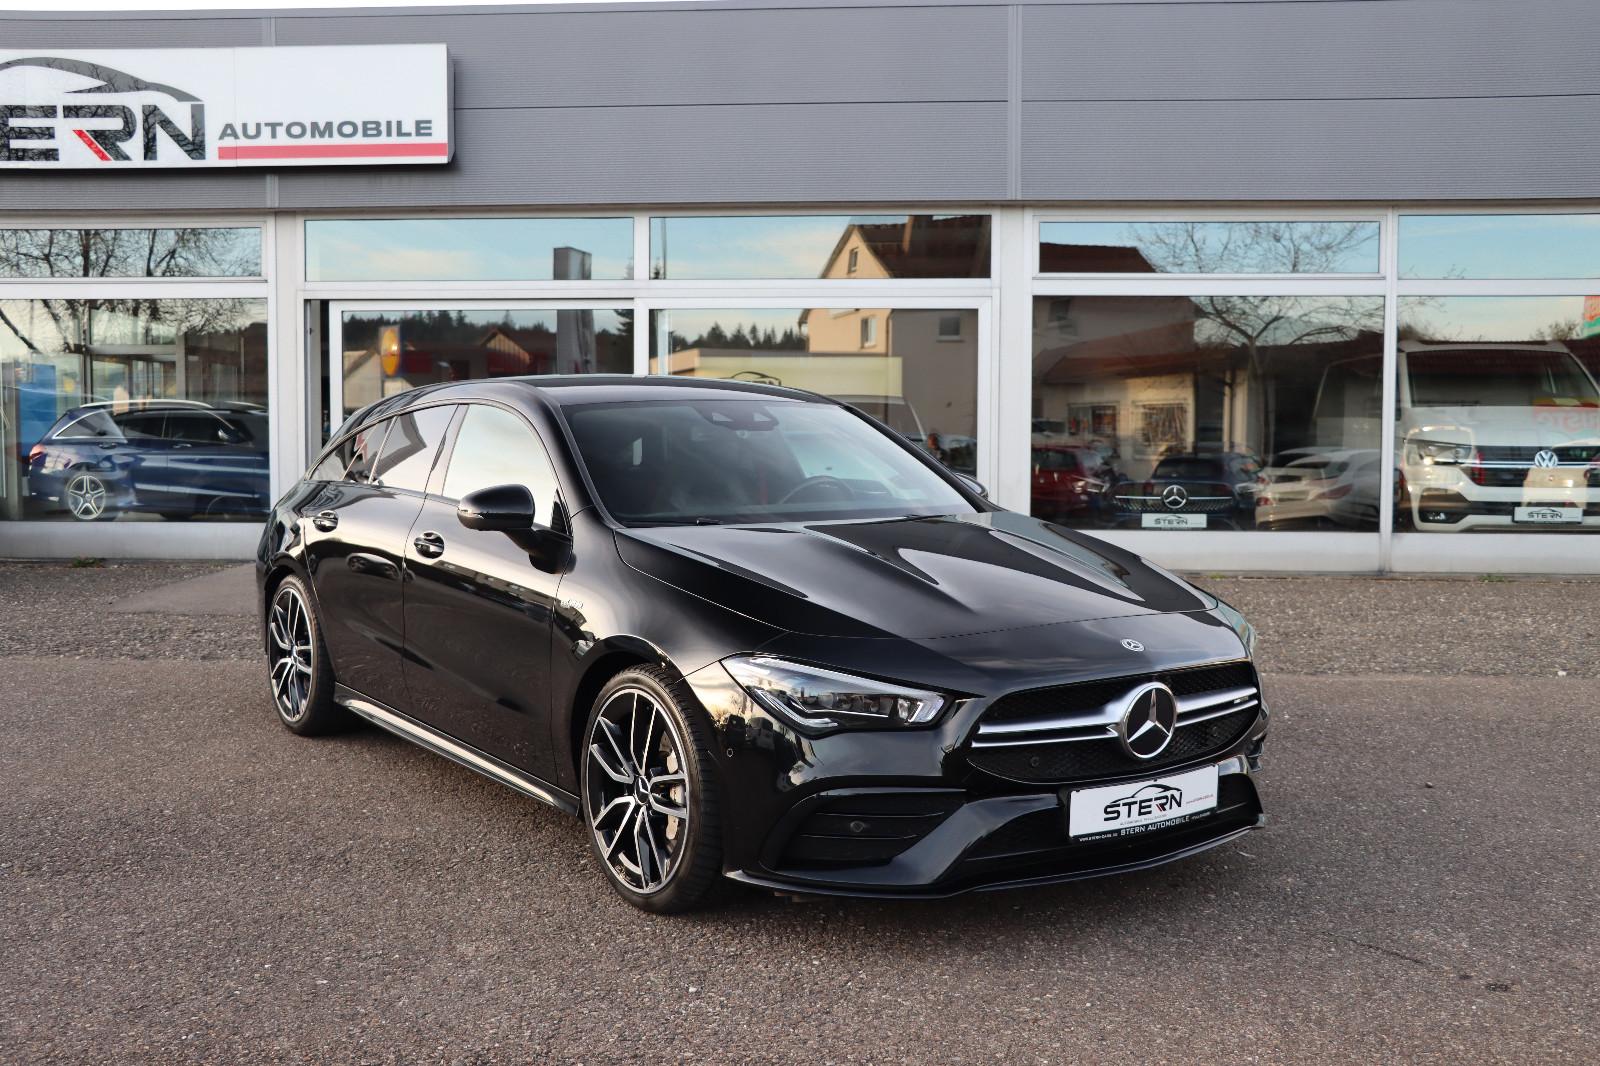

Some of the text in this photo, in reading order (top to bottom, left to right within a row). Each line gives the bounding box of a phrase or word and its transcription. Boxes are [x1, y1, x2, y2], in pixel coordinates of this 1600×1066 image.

[218, 120, 433, 140] AUTOMOBILE
[1103, 791, 1182, 822] STERN
[1120, 825, 1146, 836] STERN
[1147, 815, 1190, 831] AUTOMOBILE
